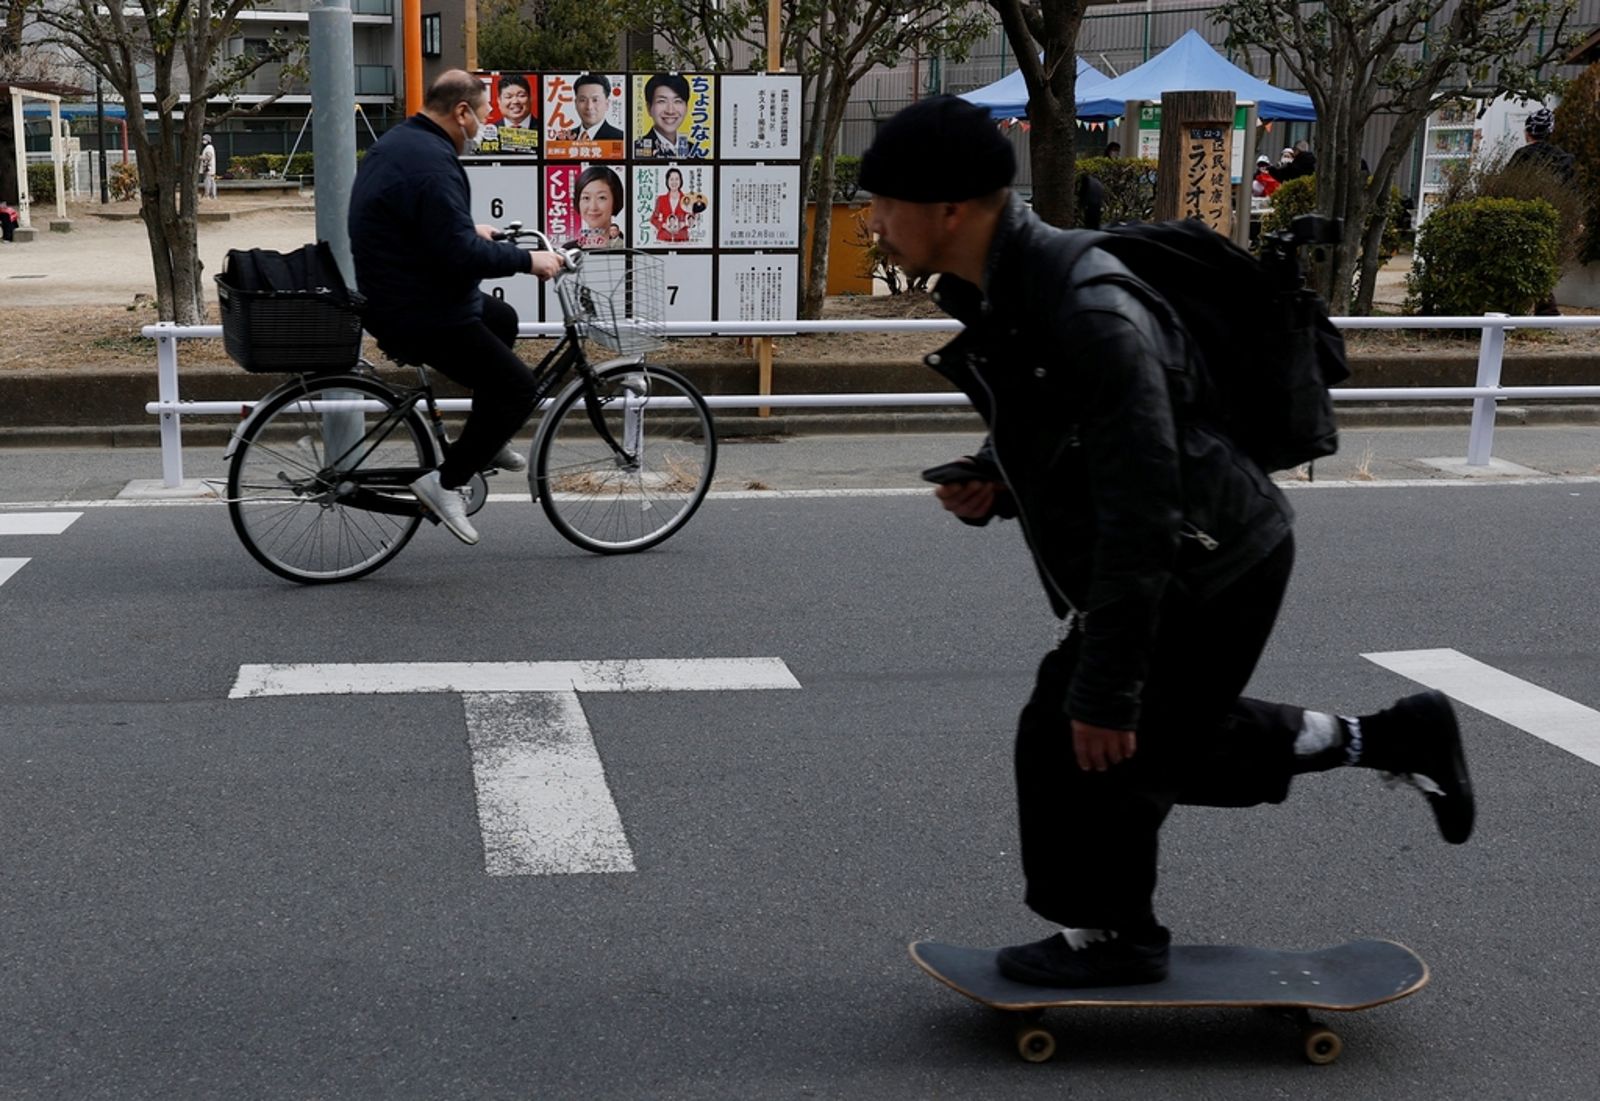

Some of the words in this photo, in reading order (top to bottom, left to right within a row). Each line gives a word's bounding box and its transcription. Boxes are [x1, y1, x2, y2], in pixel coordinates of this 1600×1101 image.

[547, 76, 574, 128] たん
[690, 76, 710, 157] ちょうなん
[568, 146, 602, 158] 参政党
[491, 198, 504, 218] 6
[548, 170, 568, 234] くしぶち
[637, 168, 654, 246] 松島みどり
[666, 286, 679, 305] 7
